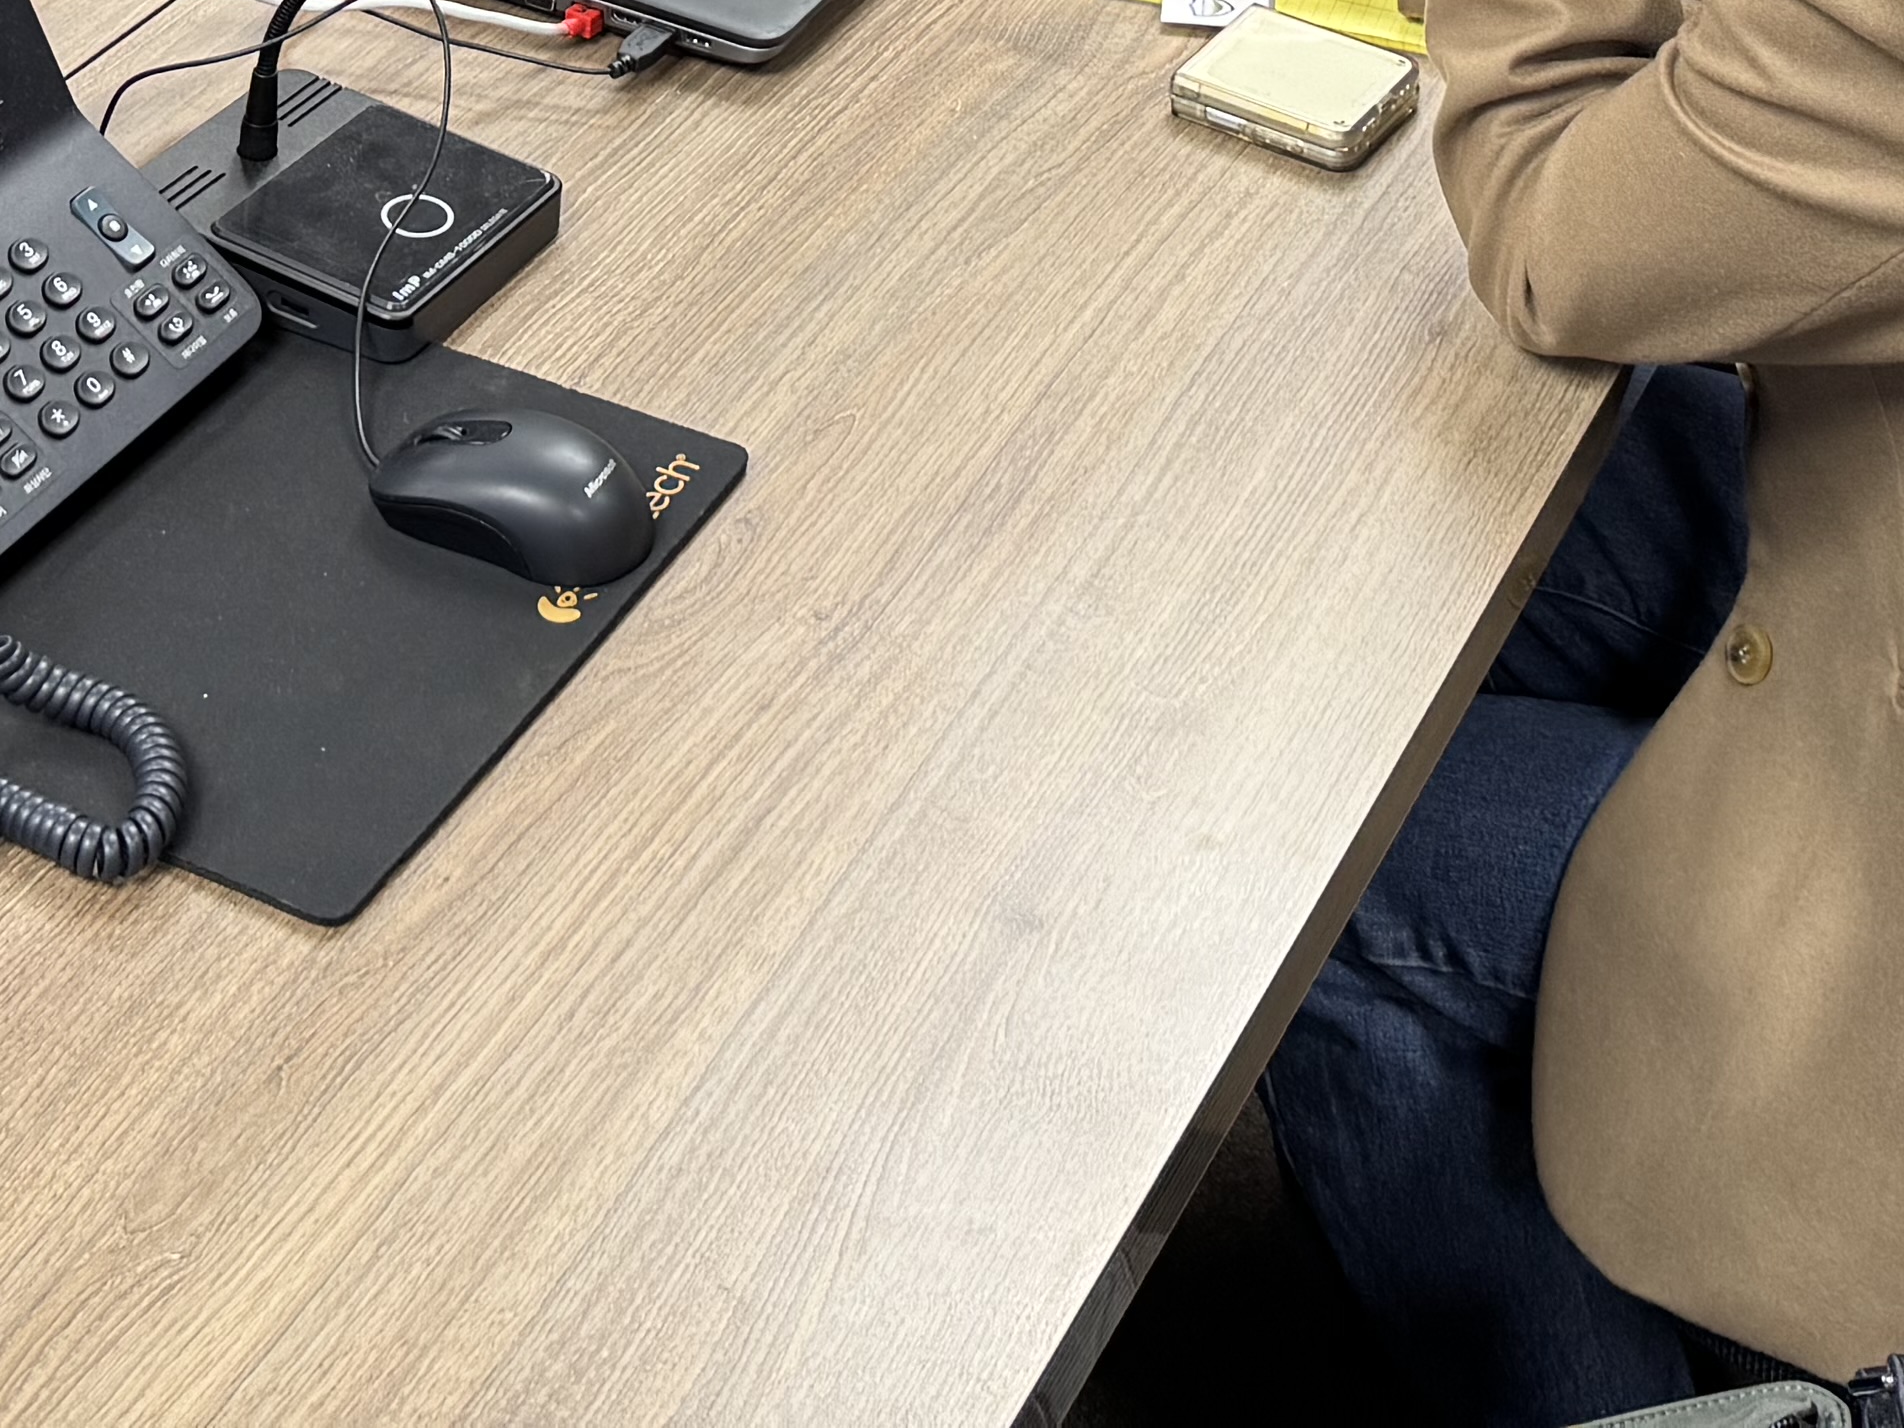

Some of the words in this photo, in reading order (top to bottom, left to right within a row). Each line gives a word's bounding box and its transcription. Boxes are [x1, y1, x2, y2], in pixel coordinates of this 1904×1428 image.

[20, 242, 34, 259] 3
[17, 305, 32, 323] 5
[54, 276, 68, 294] 6
[52, 340, 67, 357] 8
[87, 312, 102, 330] 9
[86, 377, 100, 394] 0
